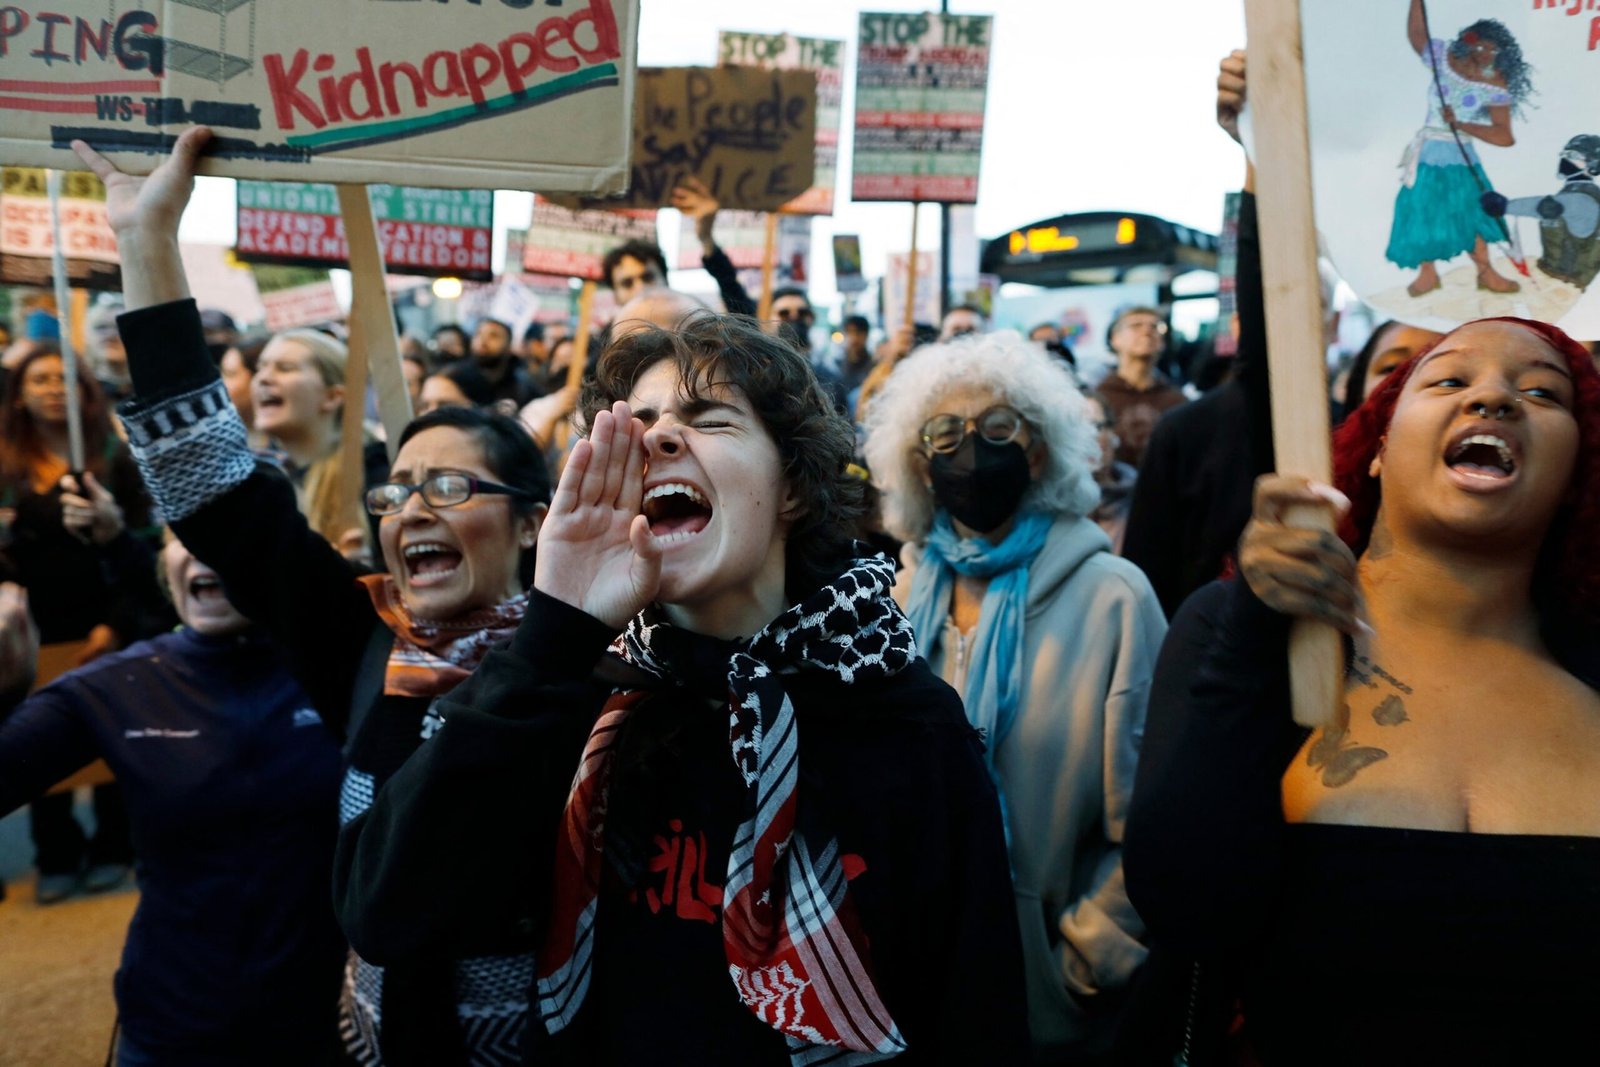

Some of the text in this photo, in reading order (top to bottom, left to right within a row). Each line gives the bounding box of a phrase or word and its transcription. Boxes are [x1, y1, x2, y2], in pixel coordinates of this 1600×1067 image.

[863, 16, 986, 44] STOP THE
[263, 0, 620, 129] Kidnapped
[722, 33, 839, 66] STOP THE
[687, 69, 807, 142] People
[711, 163, 799, 205] ICE
[239, 209, 326, 237] DEFEND
[403, 202, 491, 228] STRIKE
